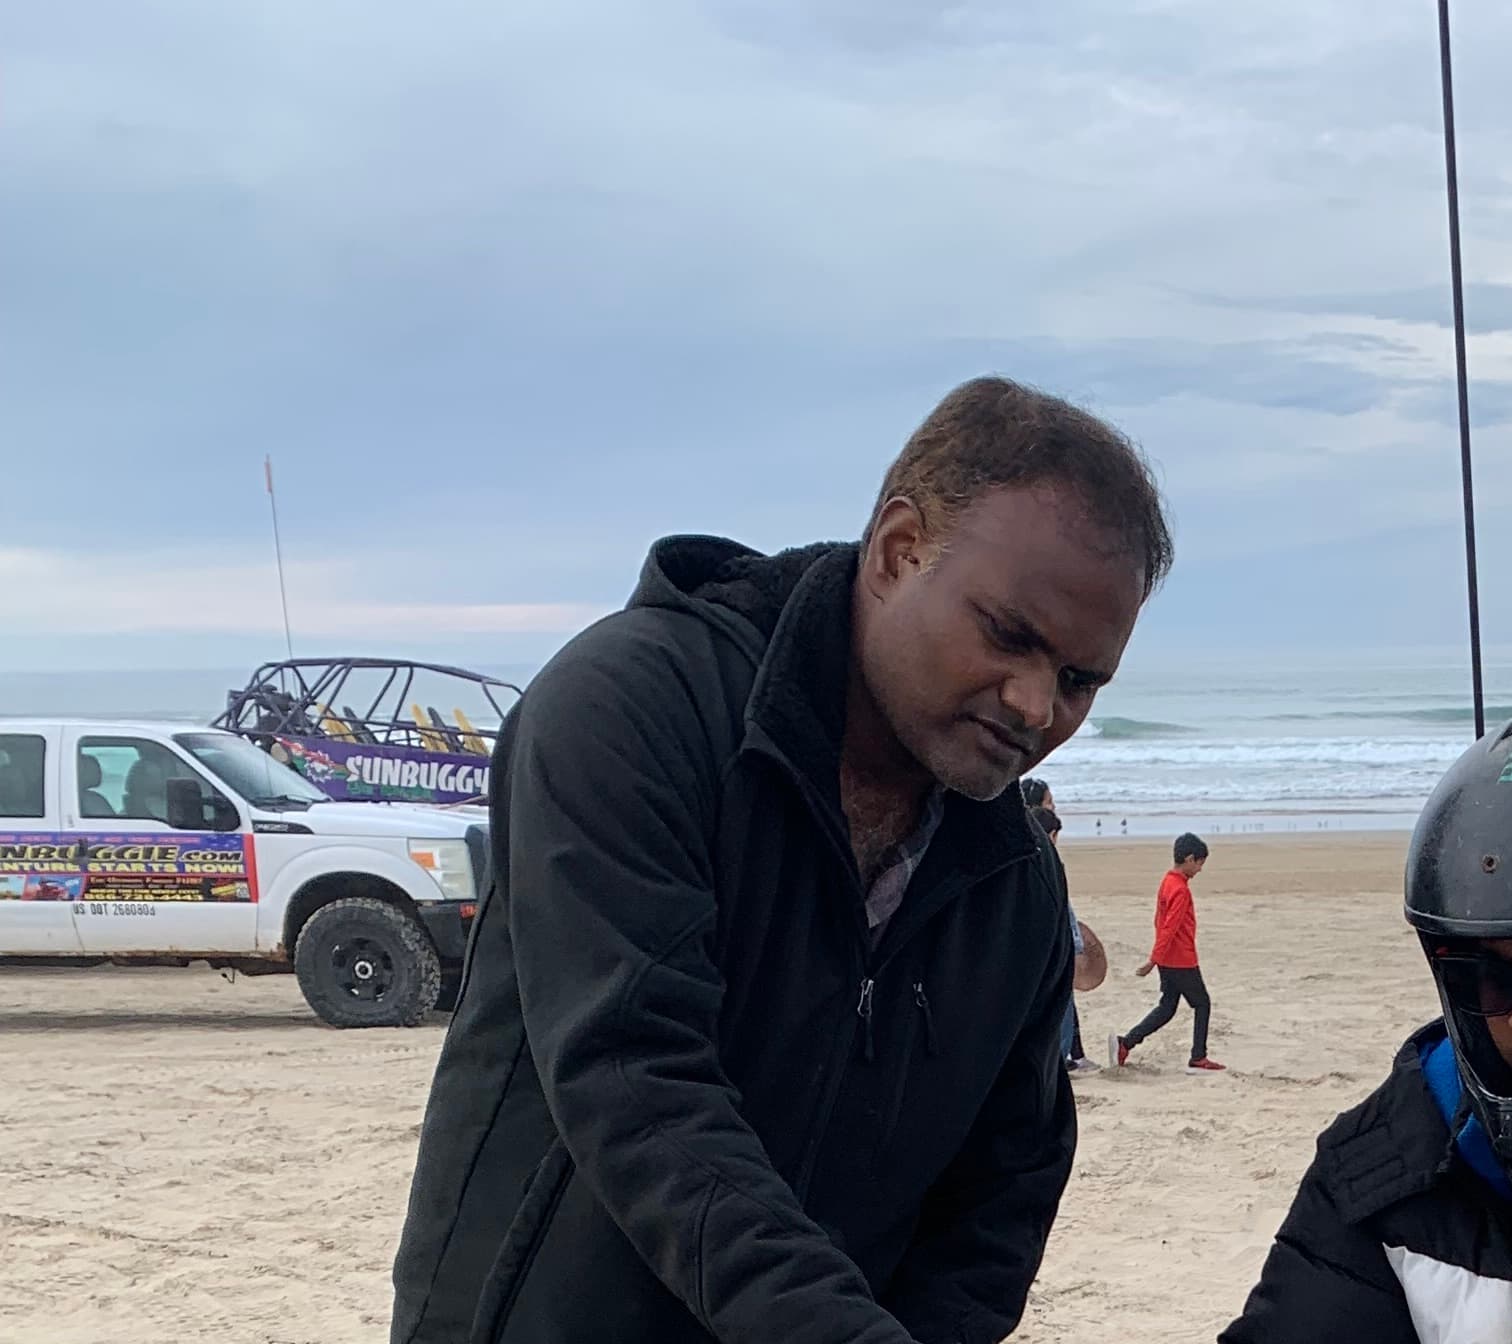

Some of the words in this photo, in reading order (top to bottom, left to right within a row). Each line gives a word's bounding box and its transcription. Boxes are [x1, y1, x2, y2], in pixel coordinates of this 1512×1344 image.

[346, 755, 489, 794] SUNBUGGY
[0, 862, 80, 872] NTURE
[87, 862, 179, 873] STARTS
[184, 863, 244, 873] NOW!
[74, 903, 85, 914] US
[90, 903, 109, 915] DOT
